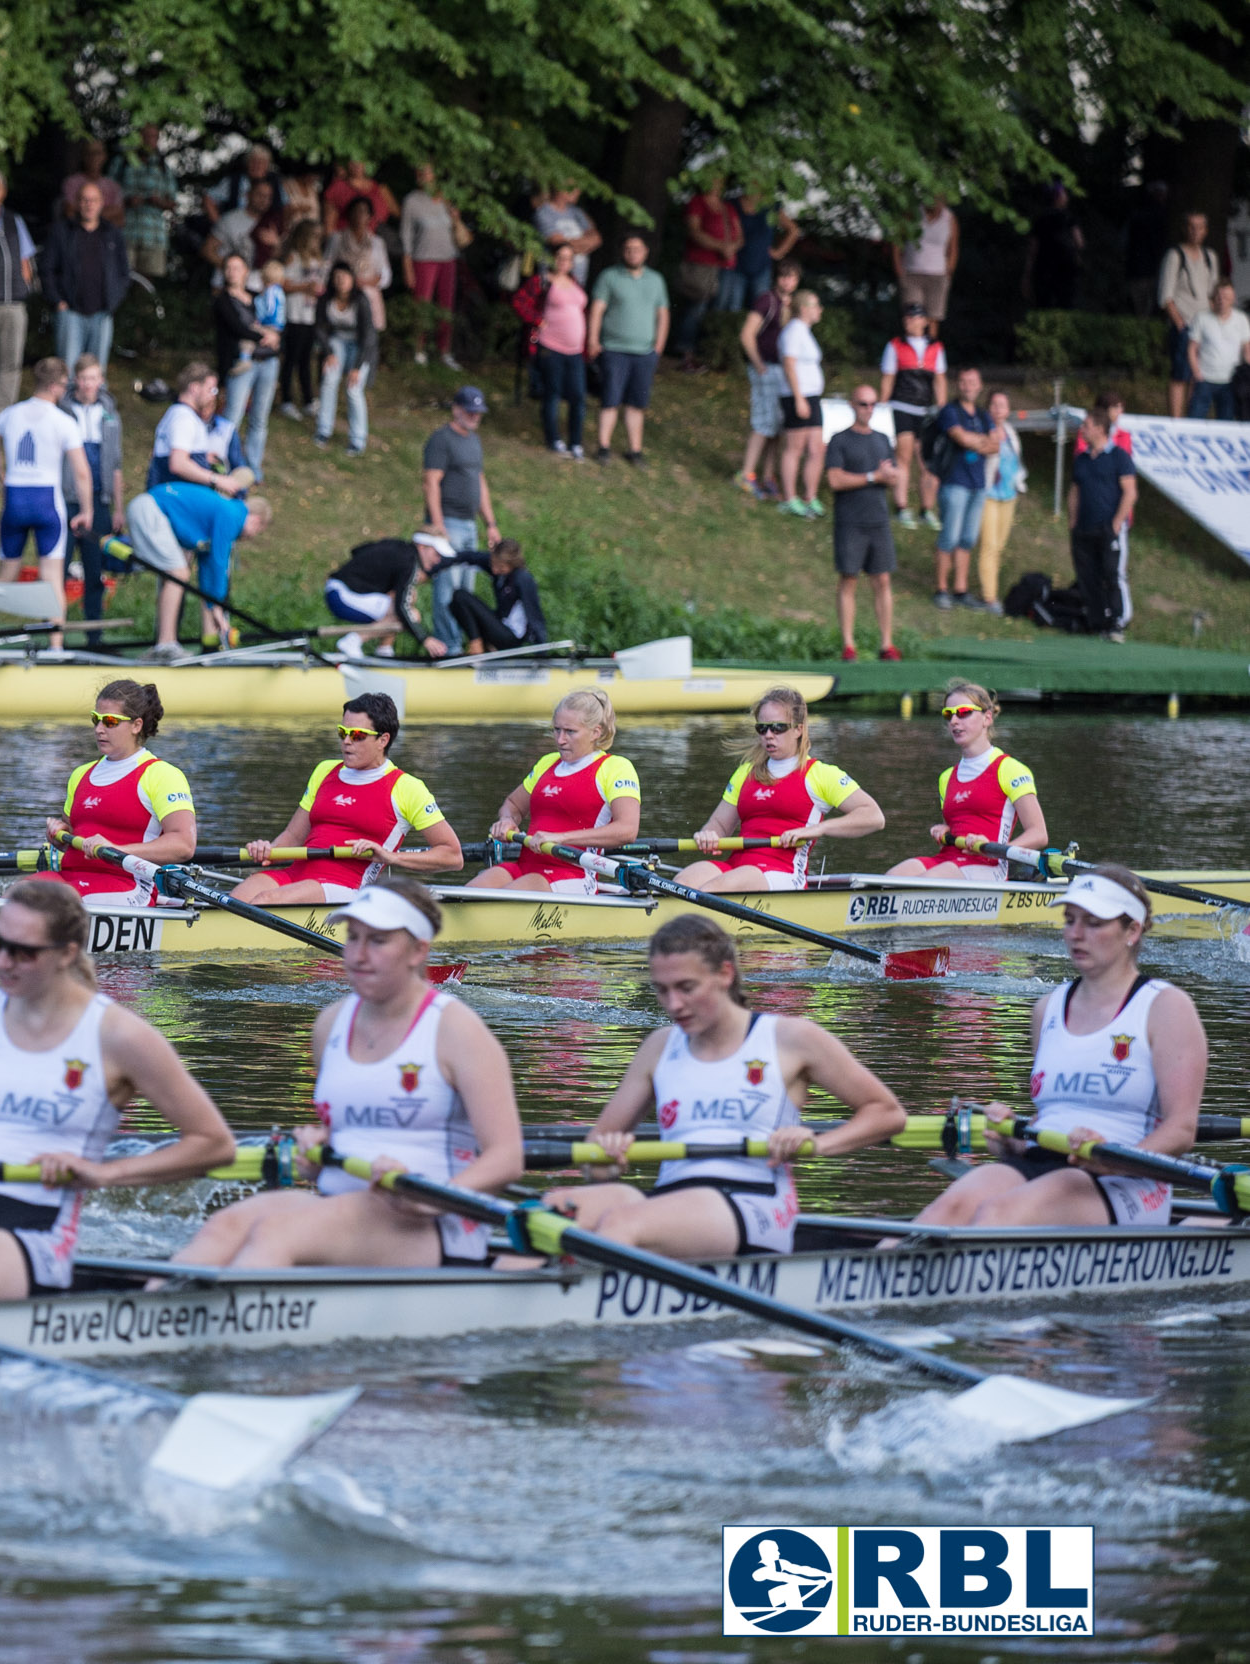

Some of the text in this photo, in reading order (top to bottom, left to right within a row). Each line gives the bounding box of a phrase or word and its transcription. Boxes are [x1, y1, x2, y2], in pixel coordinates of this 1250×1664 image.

[866, 896, 998, 915] RBL RUDER-BUNDESLIGA
[1006, 892, 1014, 908] Z
[1017, 892, 1033, 907] BS
[1053, 1072, 1129, 1096] MEV
[1, 1092, 80, 1126] MEV
[345, 1105, 420, 1128] MEV
[691, 1098, 763, 1121] MEV
[816, 1239, 1236, 1304] MEINEBOOTSVERSICHERUNG.DE
[28, 1289, 318, 1345] HavelQueen-Achter
